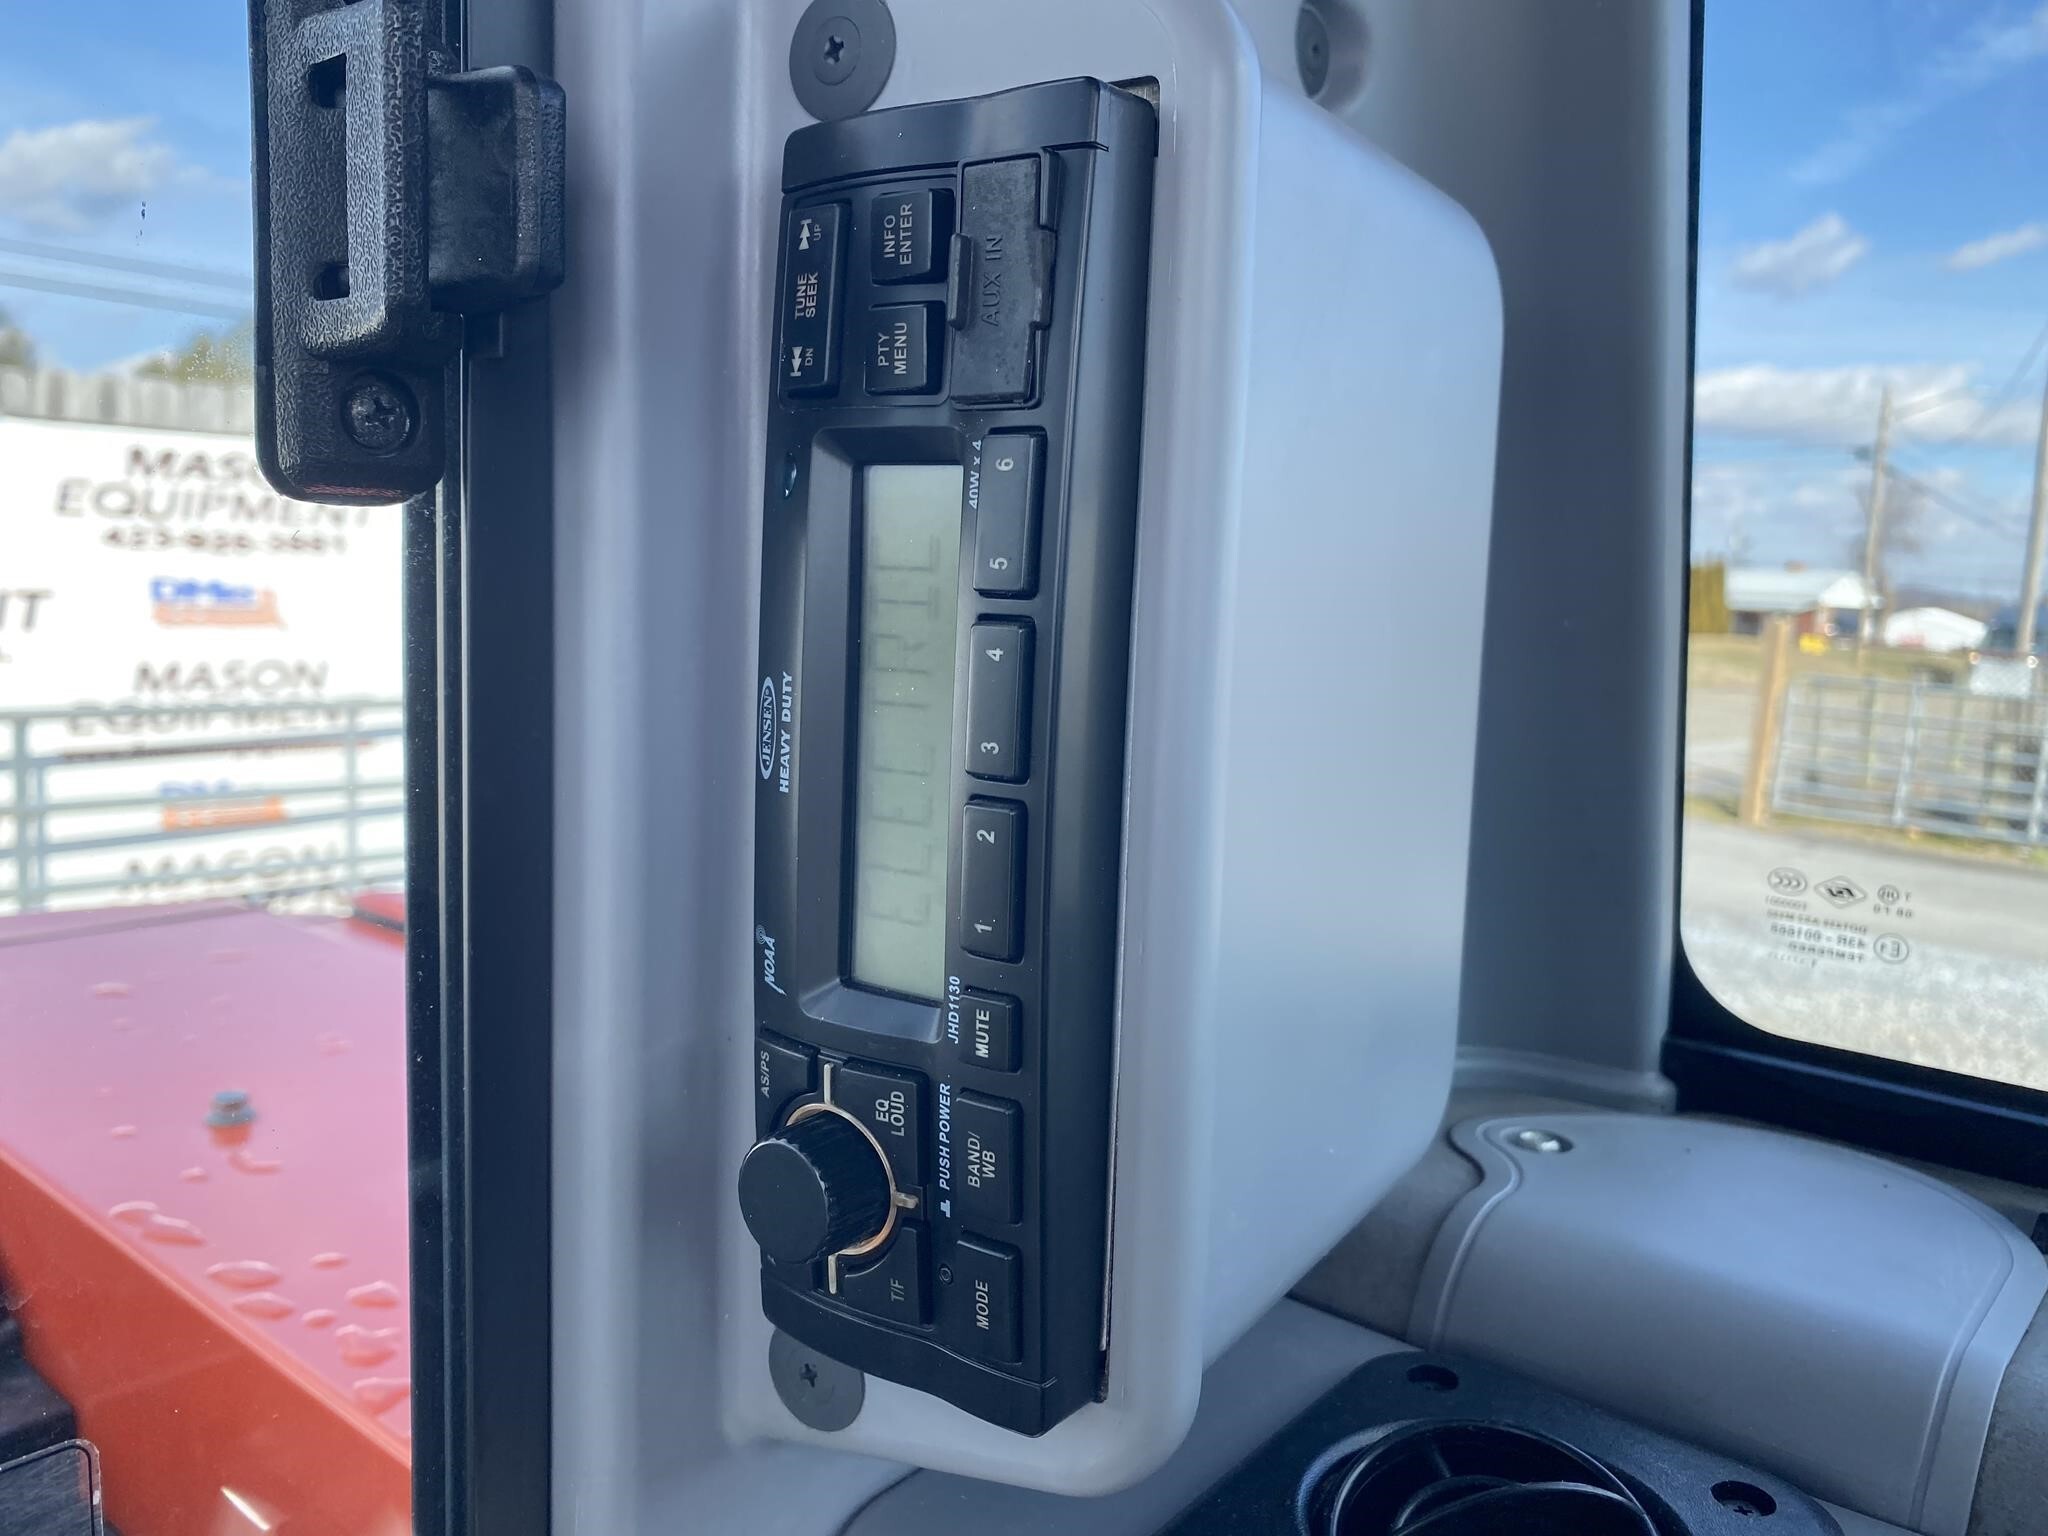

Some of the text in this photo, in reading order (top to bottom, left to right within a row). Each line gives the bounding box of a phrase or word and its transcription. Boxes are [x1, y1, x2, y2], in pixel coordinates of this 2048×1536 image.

[813, 223, 821, 241] UP
[884, 214, 896, 258] INFO
[900, 203, 912, 265] ENTER
[795, 273, 807, 320] TUNE
[805, 272, 818, 318] SEEK
[982, 235, 1003, 327] AUX IN
[805, 348, 814, 367] DN
[878, 332, 890, 367] PTY
[894, 322, 907, 375] MENU
[126, 445, 264, 481] MAS
[996, 457, 1014, 471] 6
[968, 470, 980, 510] 40W
[990, 557, 1008, 571] 5
[985, 648, 1004, 662] 4
[133, 660, 328, 693] MASON
[779, 671, 794, 793] HEAVY DUTY
[980, 741, 1000, 755] 3
[976, 829, 995, 844] 2
[974, 920, 993, 934] 1
[763, 936, 787, 996] NOAA
[948, 975, 961, 1045] JHD1130
[975, 1008, 990, 1059] MUTE
[759, 1051, 770, 1098] AS/PS
[876, 1097, 890, 1122] EQ
[890, 1091, 905, 1137] LOUD
[939, 1083, 951, 1191] PUSH POWER
[967, 1130, 981, 1189] BAND/
[980, 1150, 996, 1179] WB
[890, 1278, 905, 1303] T/F
[976, 1280, 990, 1330] MODE
